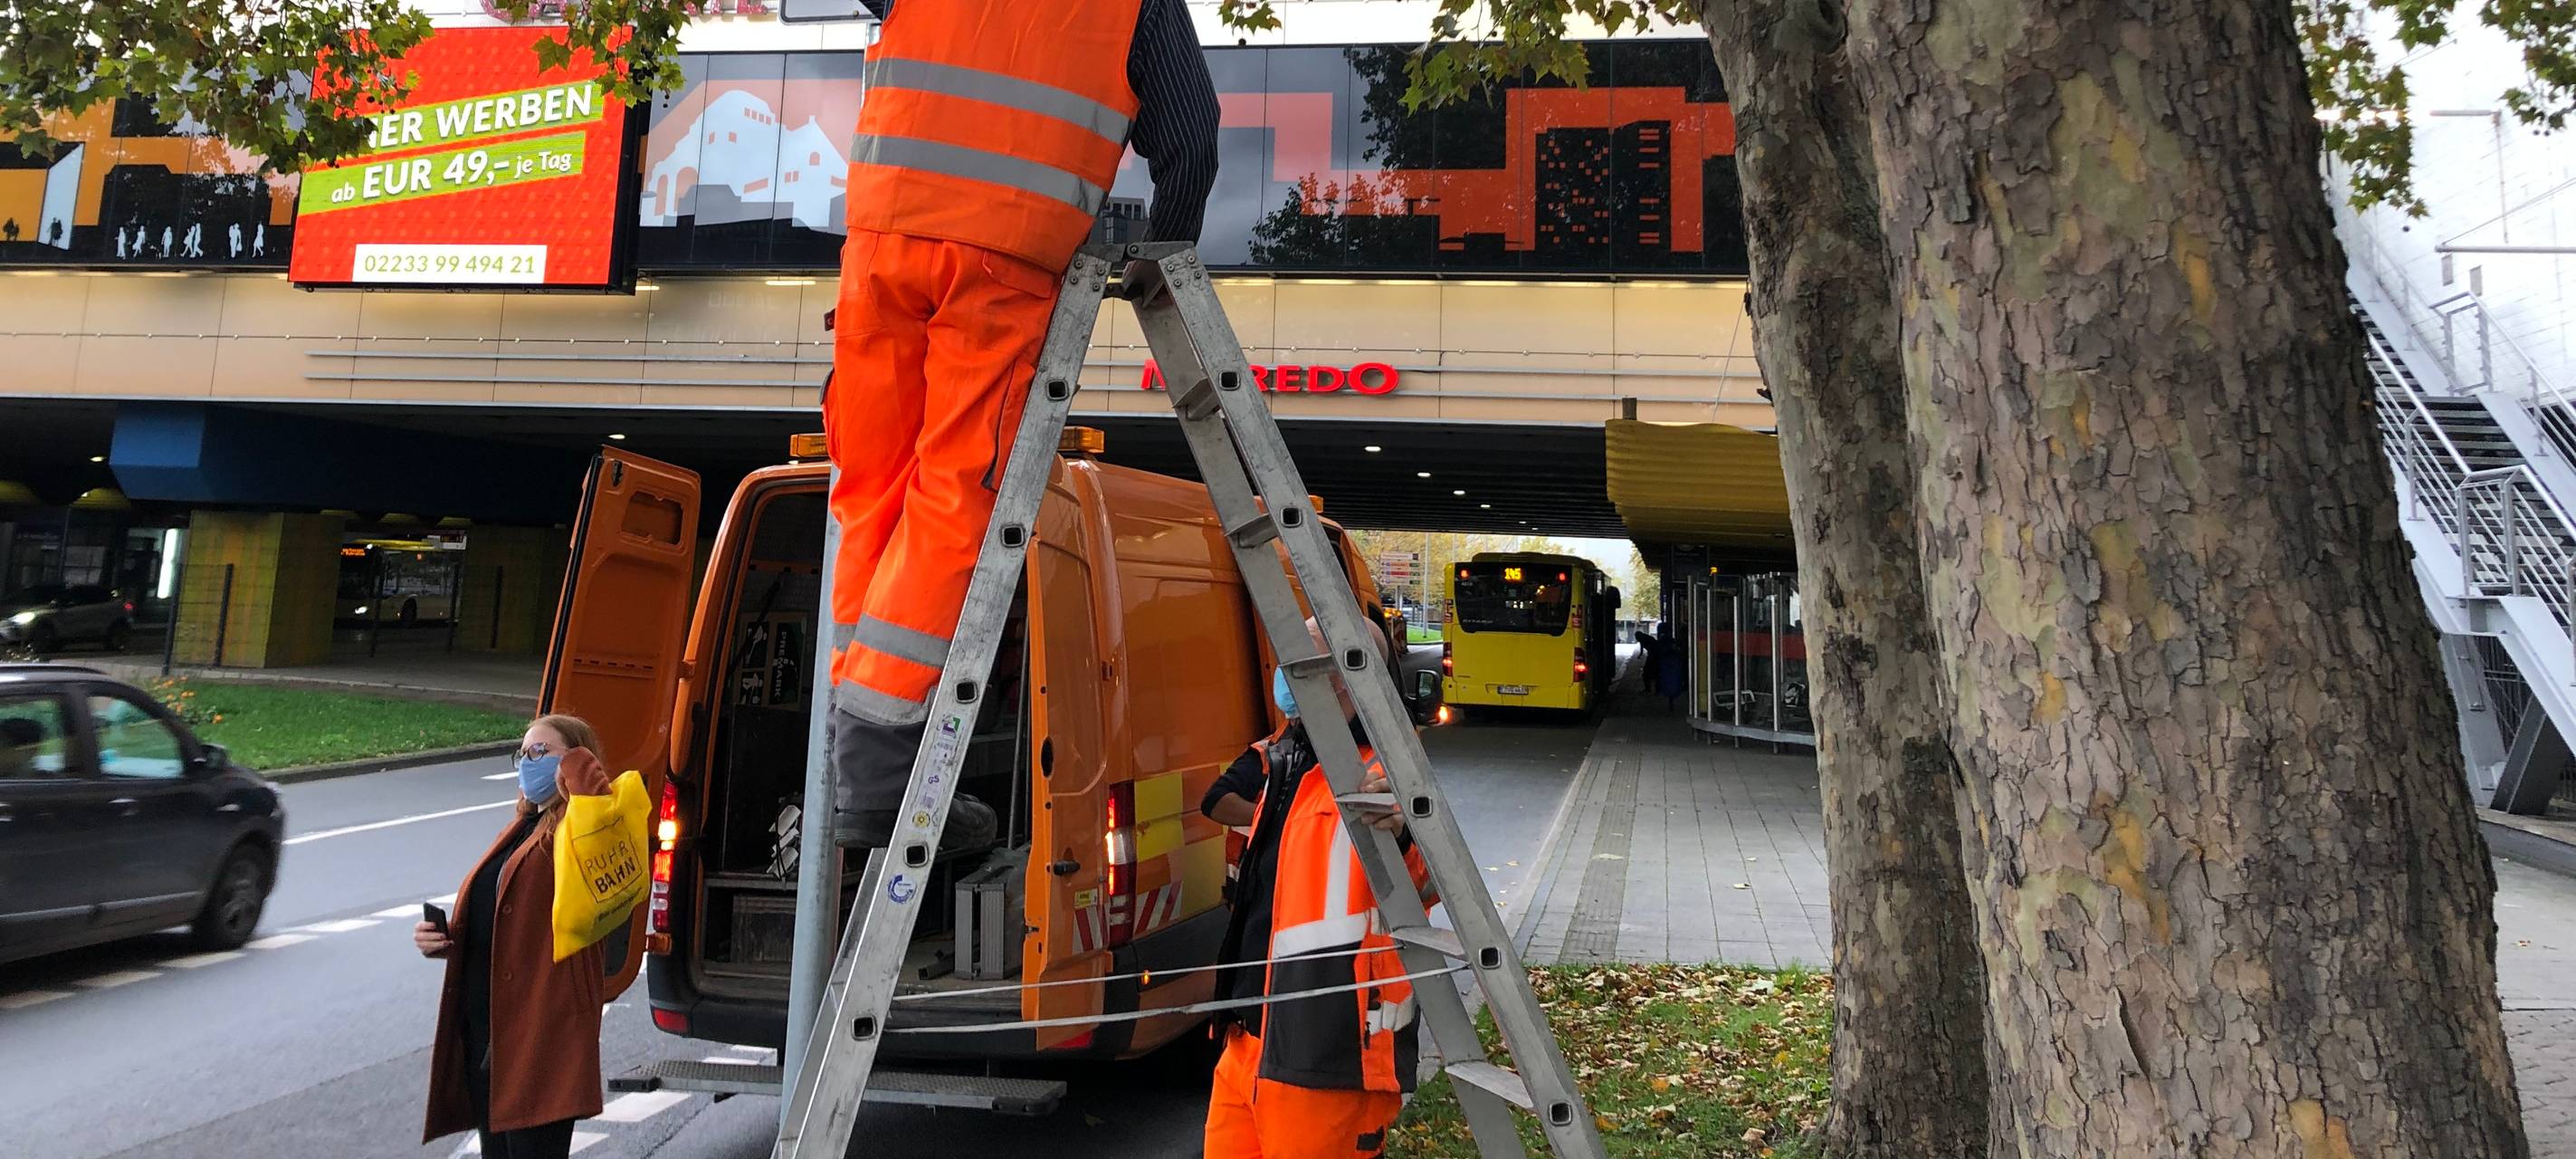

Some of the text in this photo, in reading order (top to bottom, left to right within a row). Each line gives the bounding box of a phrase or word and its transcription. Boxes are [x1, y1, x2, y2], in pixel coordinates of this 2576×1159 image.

[368, 84, 593, 148] IER WERBEN
[331, 182, 356, 203] ab
[362, 158, 433, 199] EUR
[513, 155, 533, 178] je
[538, 149, 572, 172] Tag
[364, 254, 534, 273] 02233 99 494 21
[774, 631, 787, 698] PREMARK
[584, 840, 628, 875] RUHR
[595, 857, 635, 894] BAHN
